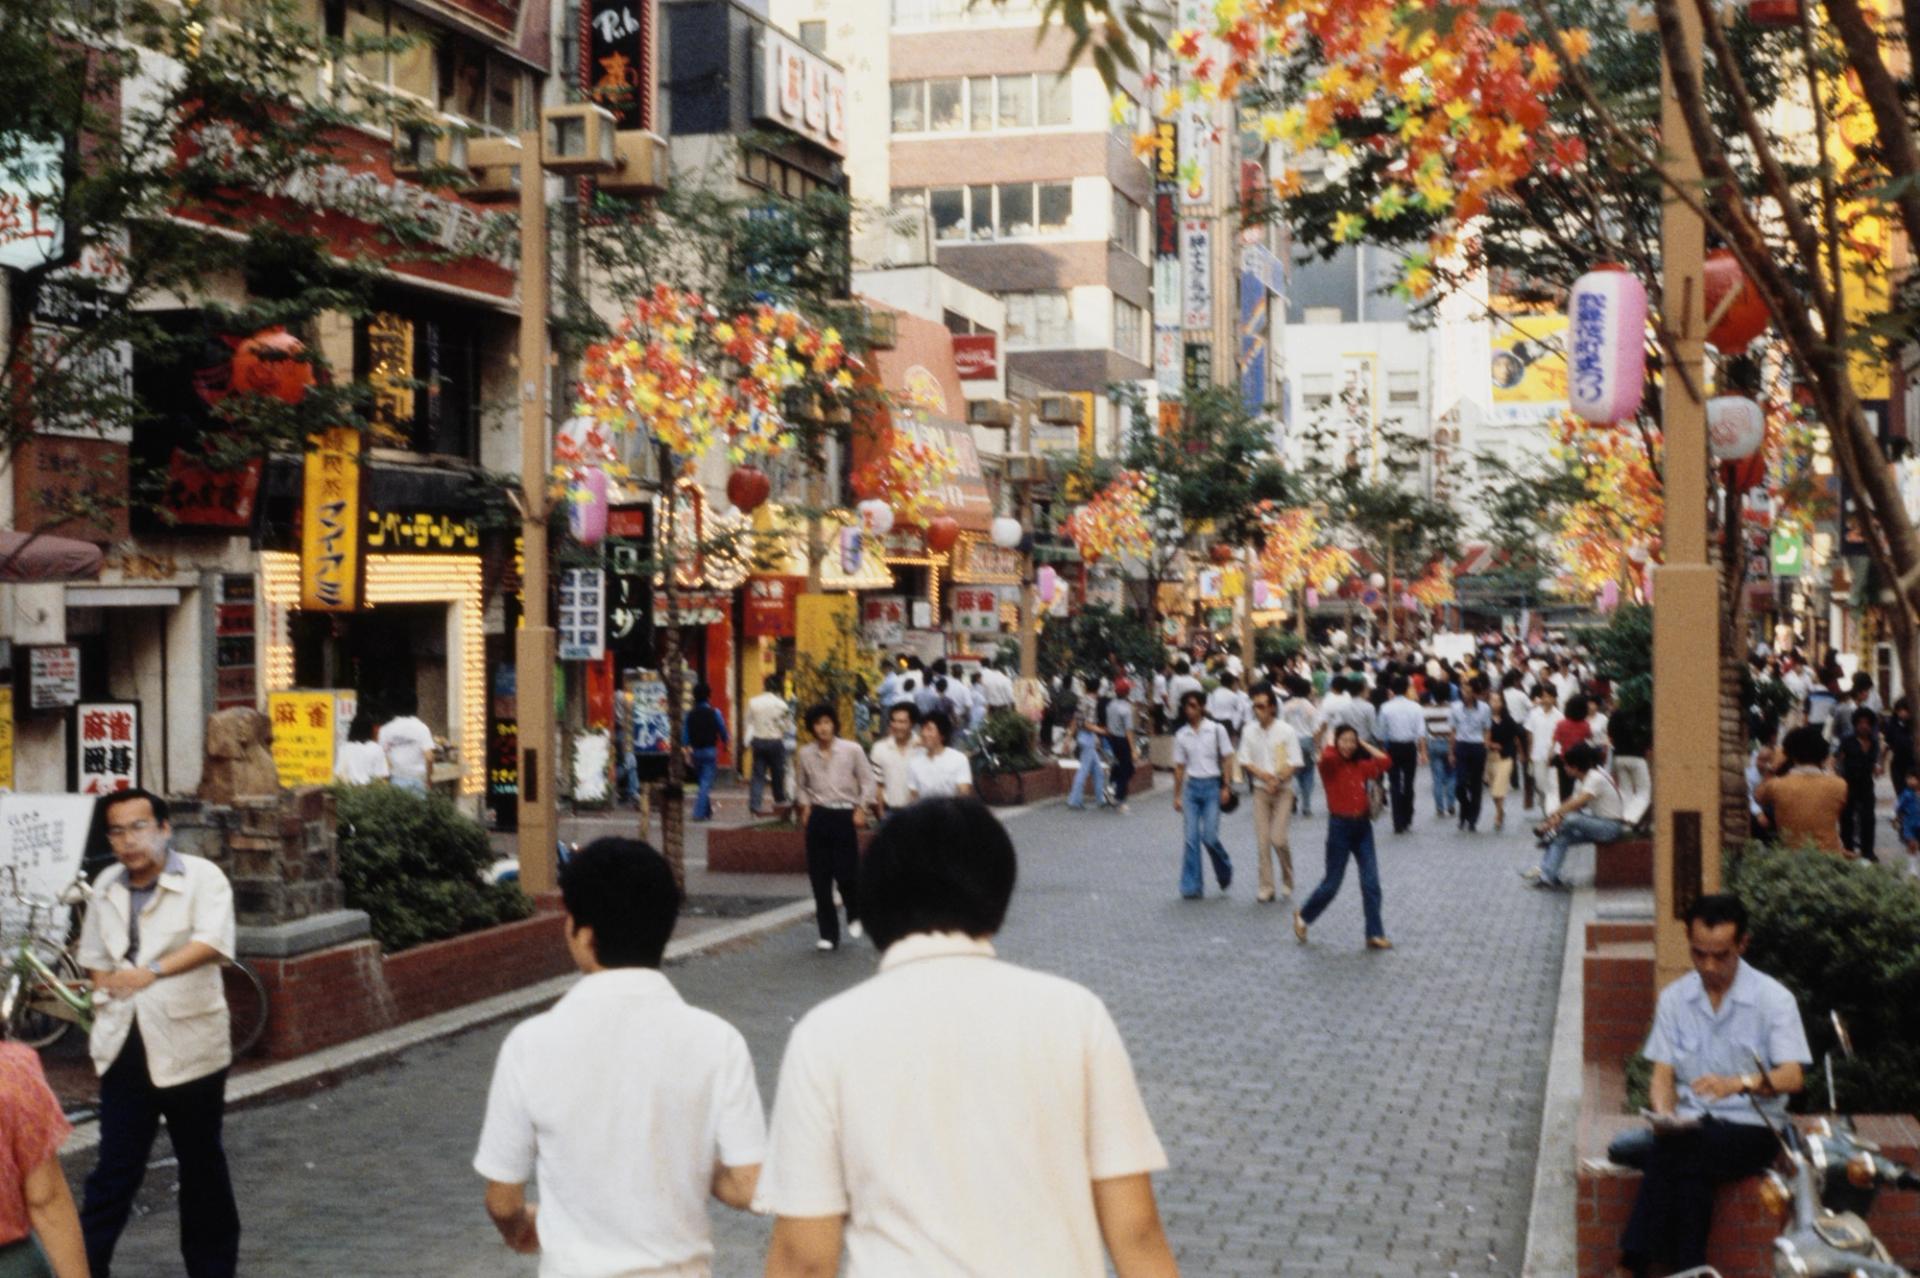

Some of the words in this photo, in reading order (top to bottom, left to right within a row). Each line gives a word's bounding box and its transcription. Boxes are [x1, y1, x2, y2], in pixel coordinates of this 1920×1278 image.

[610, 545, 643, 639] ローザ
[83, 709, 132, 741] 麻雀
[275, 700, 328, 728] 麻雀
